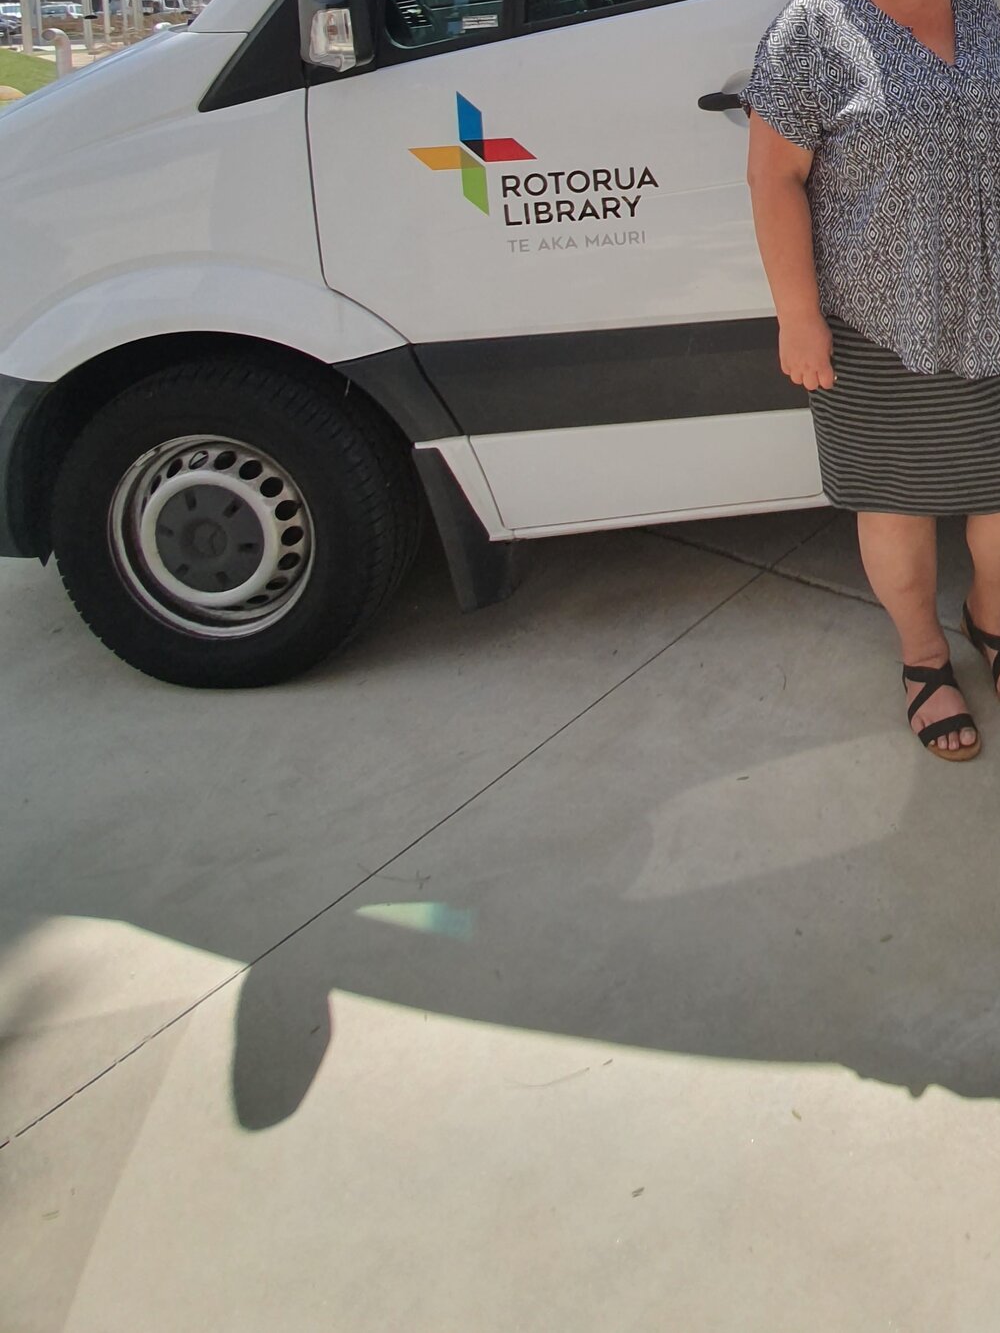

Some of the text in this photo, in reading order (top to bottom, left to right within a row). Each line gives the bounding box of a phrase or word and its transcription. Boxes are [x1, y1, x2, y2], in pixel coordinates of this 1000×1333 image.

[501, 166, 660, 199] ROTORUA
[503, 195, 642, 227] LIBRARY
[507, 230, 646, 254] TE AKA MAURI
